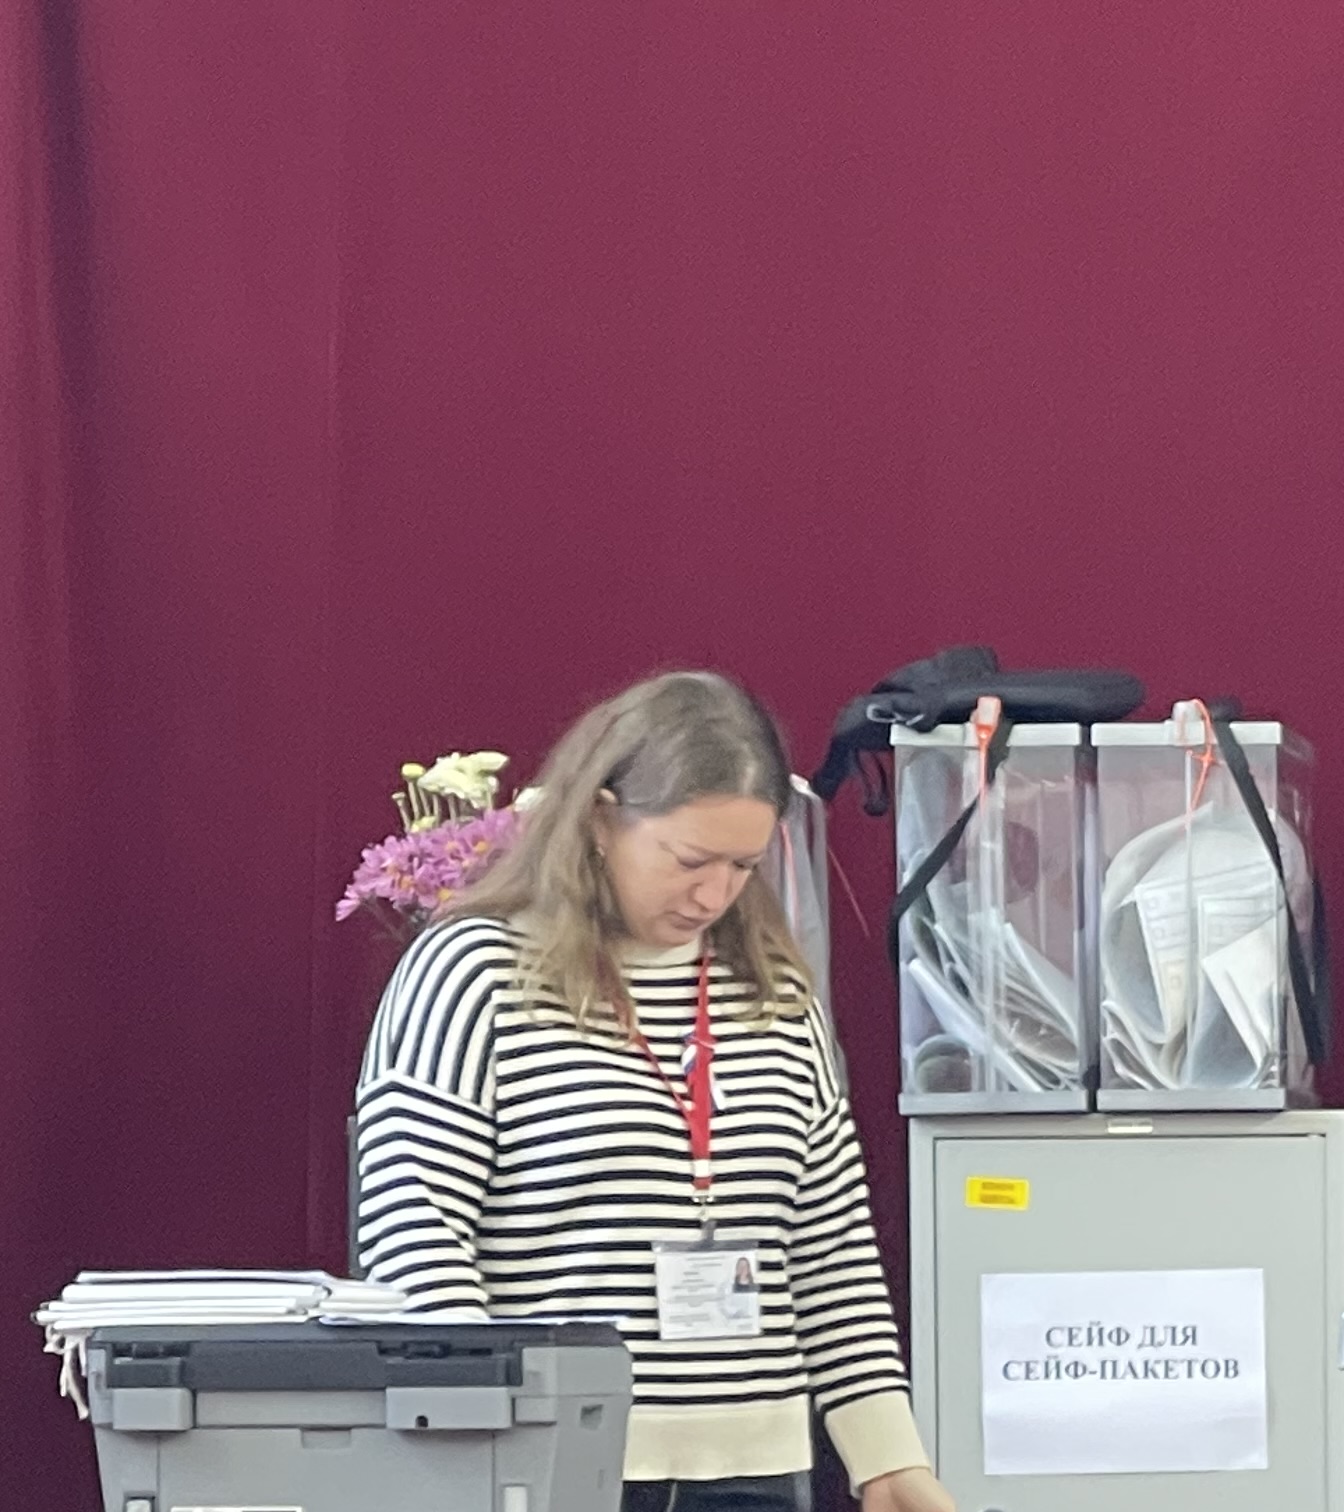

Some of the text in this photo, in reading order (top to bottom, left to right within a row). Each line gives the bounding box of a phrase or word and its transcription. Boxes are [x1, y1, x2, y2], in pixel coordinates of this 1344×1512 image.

[1045, 1321, 1198, 1349] СЕЙФ ДЛЯ
[1002, 1355, 1240, 1381] СЕЙФ-ПАКЕТОВ
